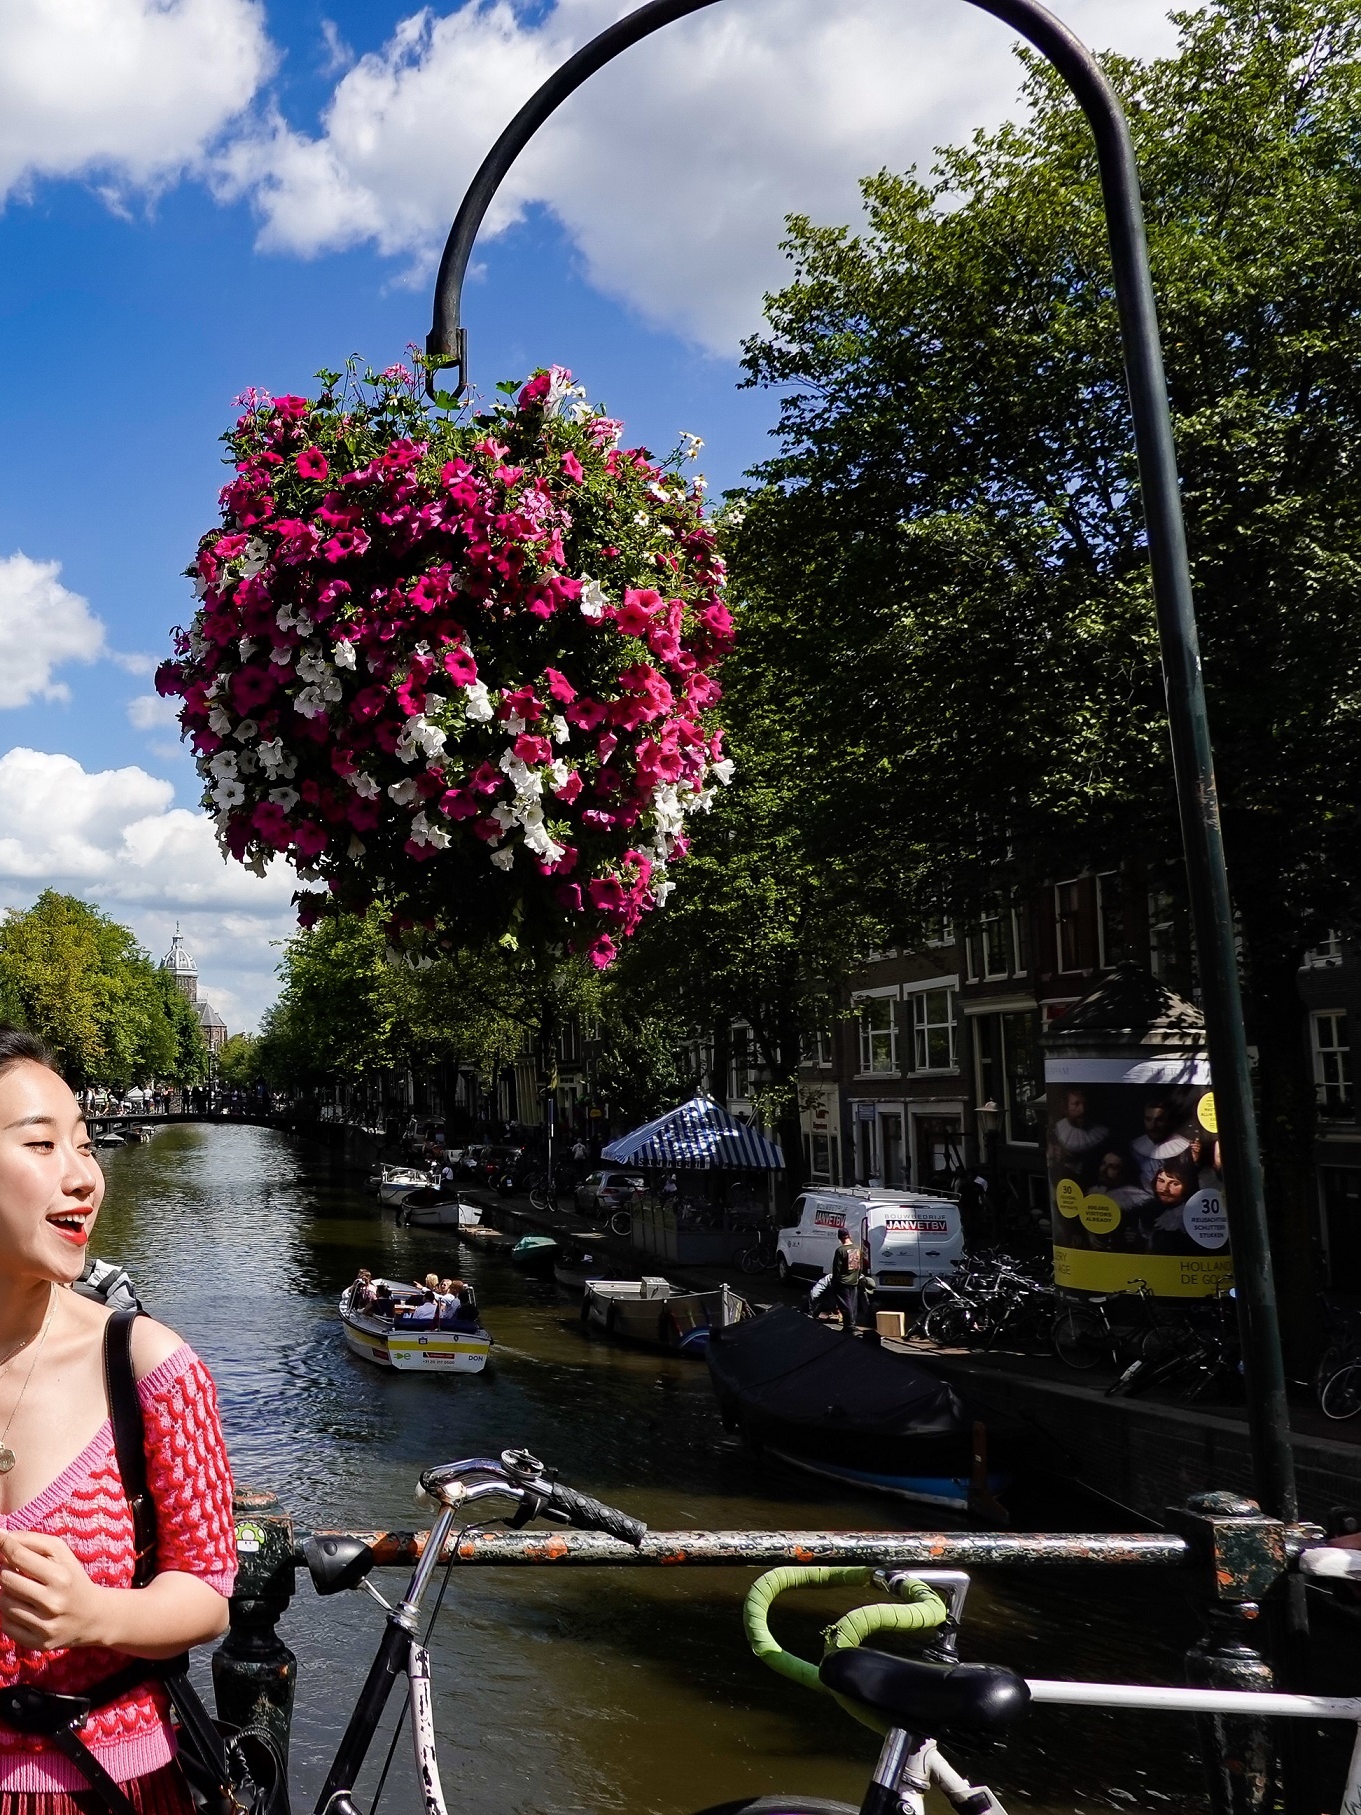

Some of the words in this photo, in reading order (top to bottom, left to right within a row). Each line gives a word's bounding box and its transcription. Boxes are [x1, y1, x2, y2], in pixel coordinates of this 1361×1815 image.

[1063, 1185, 1073, 1195] 30
[1201, 1198, 1220, 1215] 30
[1181, 1274, 1199, 1285] DE
